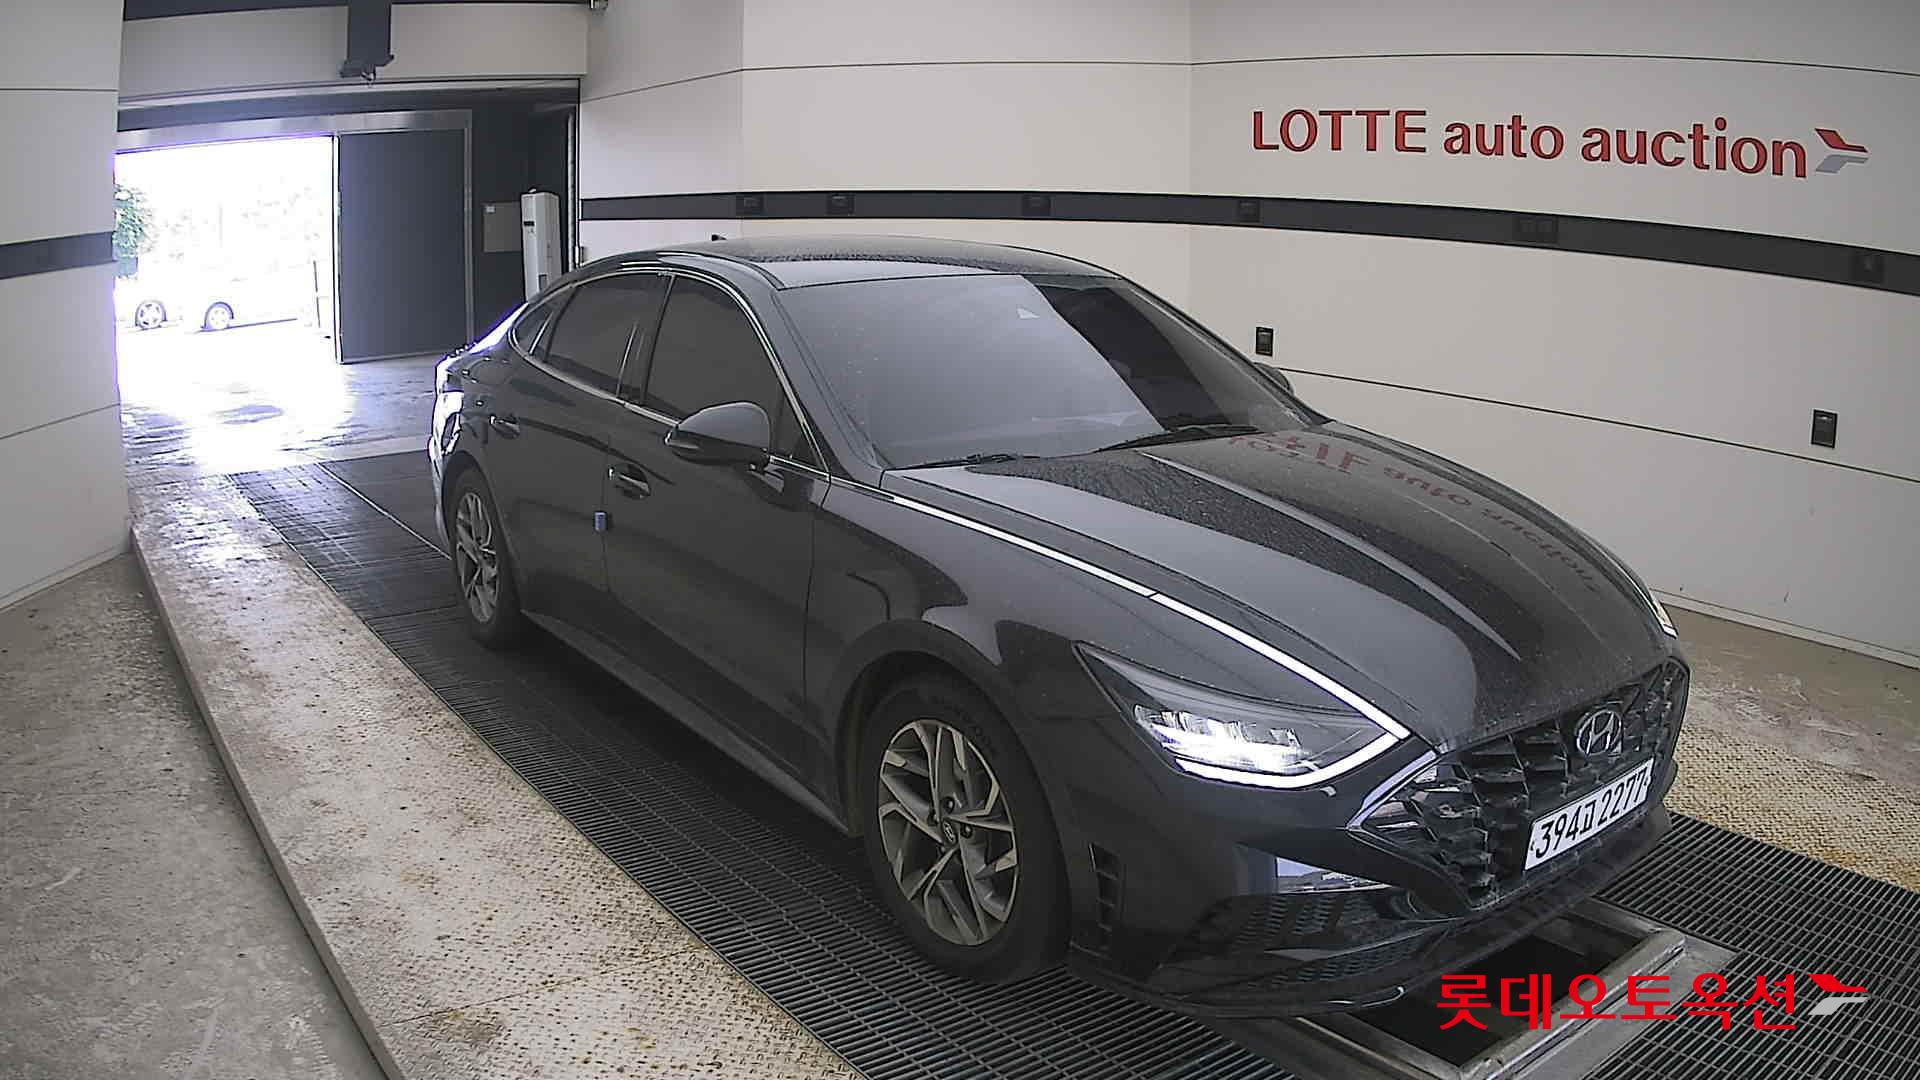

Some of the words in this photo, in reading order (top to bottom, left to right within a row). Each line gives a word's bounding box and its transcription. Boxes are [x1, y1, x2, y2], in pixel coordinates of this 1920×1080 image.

[1253, 110, 1426, 152] LOTTE
[1443, 115, 1565, 159] auto
[1581, 117, 1807, 178] auction
[1597, 766, 1648, 827] 2277
